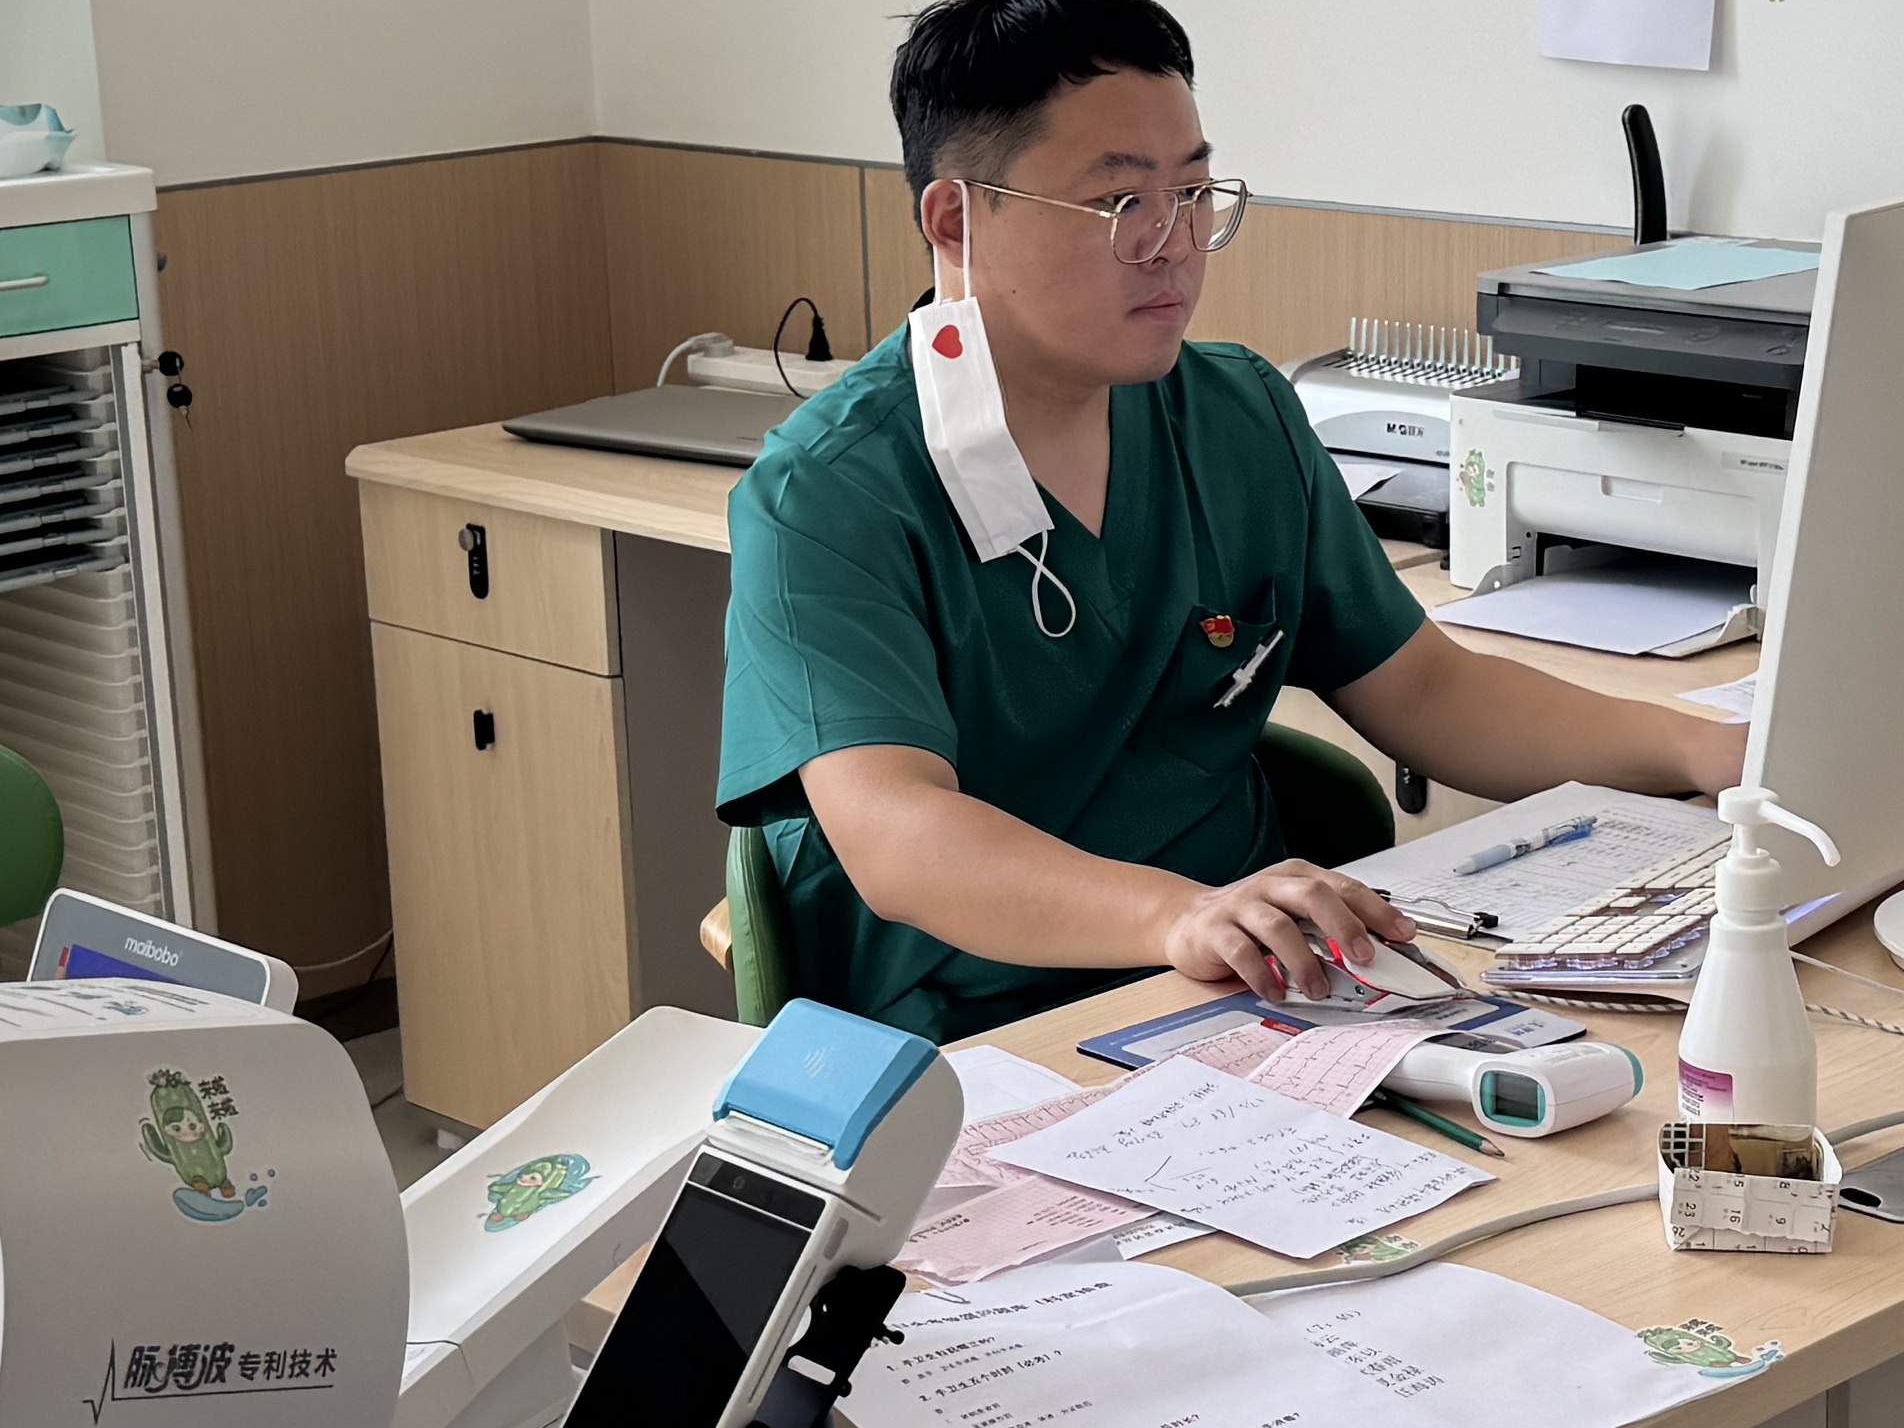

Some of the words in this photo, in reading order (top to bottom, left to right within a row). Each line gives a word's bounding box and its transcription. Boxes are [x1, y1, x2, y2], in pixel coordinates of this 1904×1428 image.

[125, 936, 179, 967] maibobo
[238, 1348, 337, 1382] 专利技术
